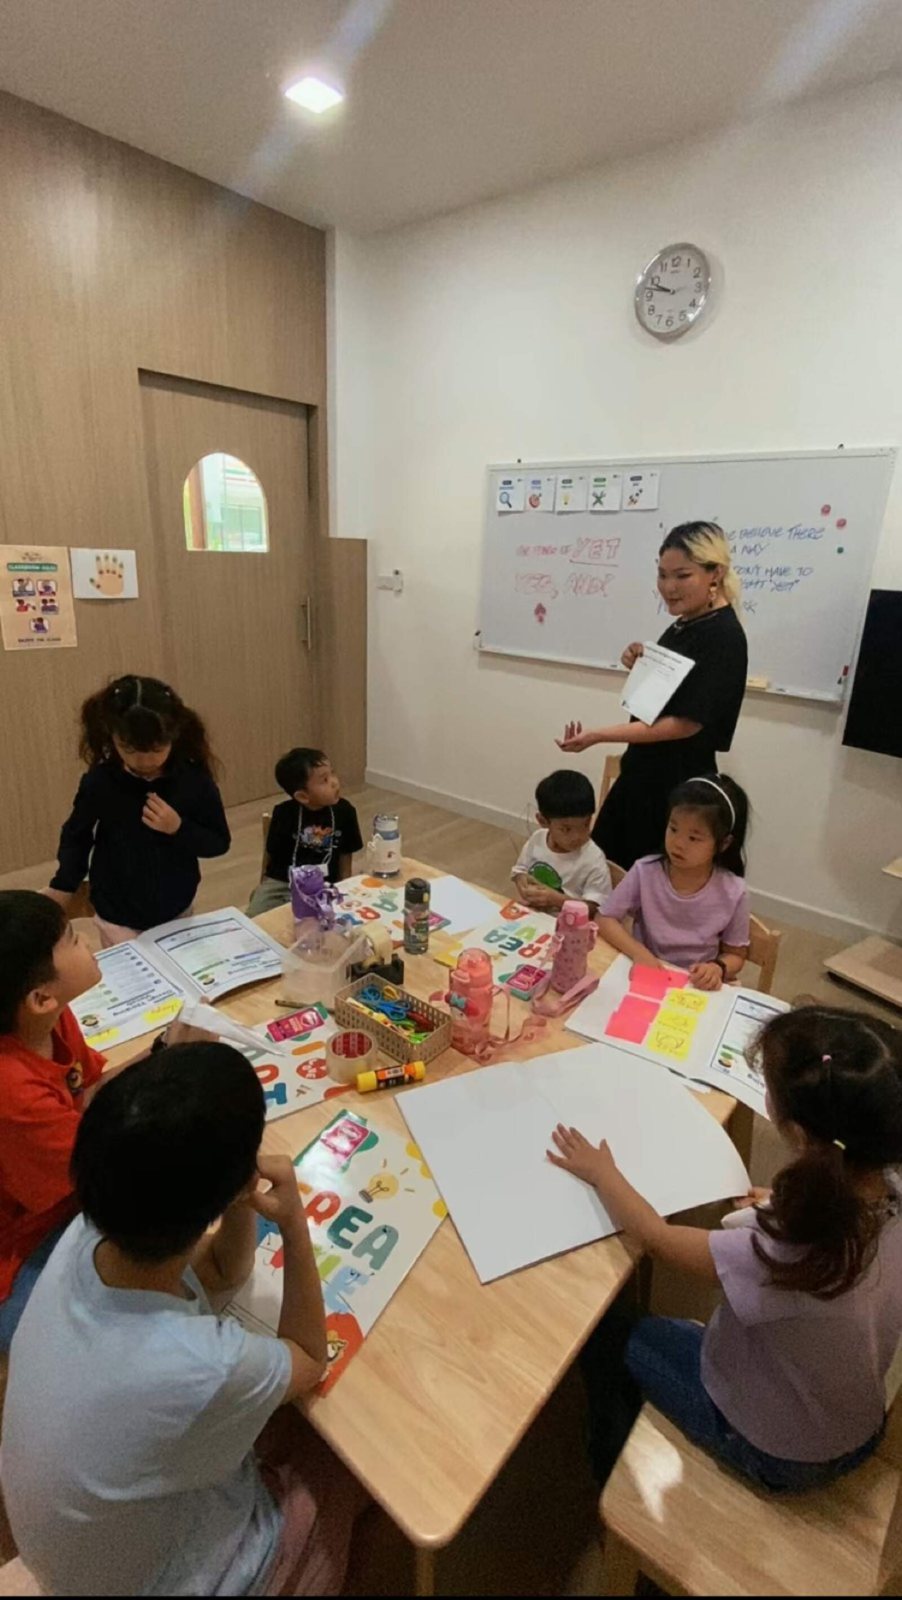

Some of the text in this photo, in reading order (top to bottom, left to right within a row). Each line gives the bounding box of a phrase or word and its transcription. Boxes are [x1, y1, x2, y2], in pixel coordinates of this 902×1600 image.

[661, 262, 668, 273] 11
[672, 256, 681, 268] 12
[693, 268, 701, 279] 2
[695, 282, 702, 293] 3
[646, 290, 654, 302] 9
[689, 299, 696, 308] 4
[648, 305, 656, 316] 8
[679, 310, 687, 321] 5
[656, 315, 663, 325] 7
[666, 316, 674, 327] 6
[788, 524, 826, 541] THERE
[765, 566, 793, 578] HAVE
[798, 568, 815, 577] TO
